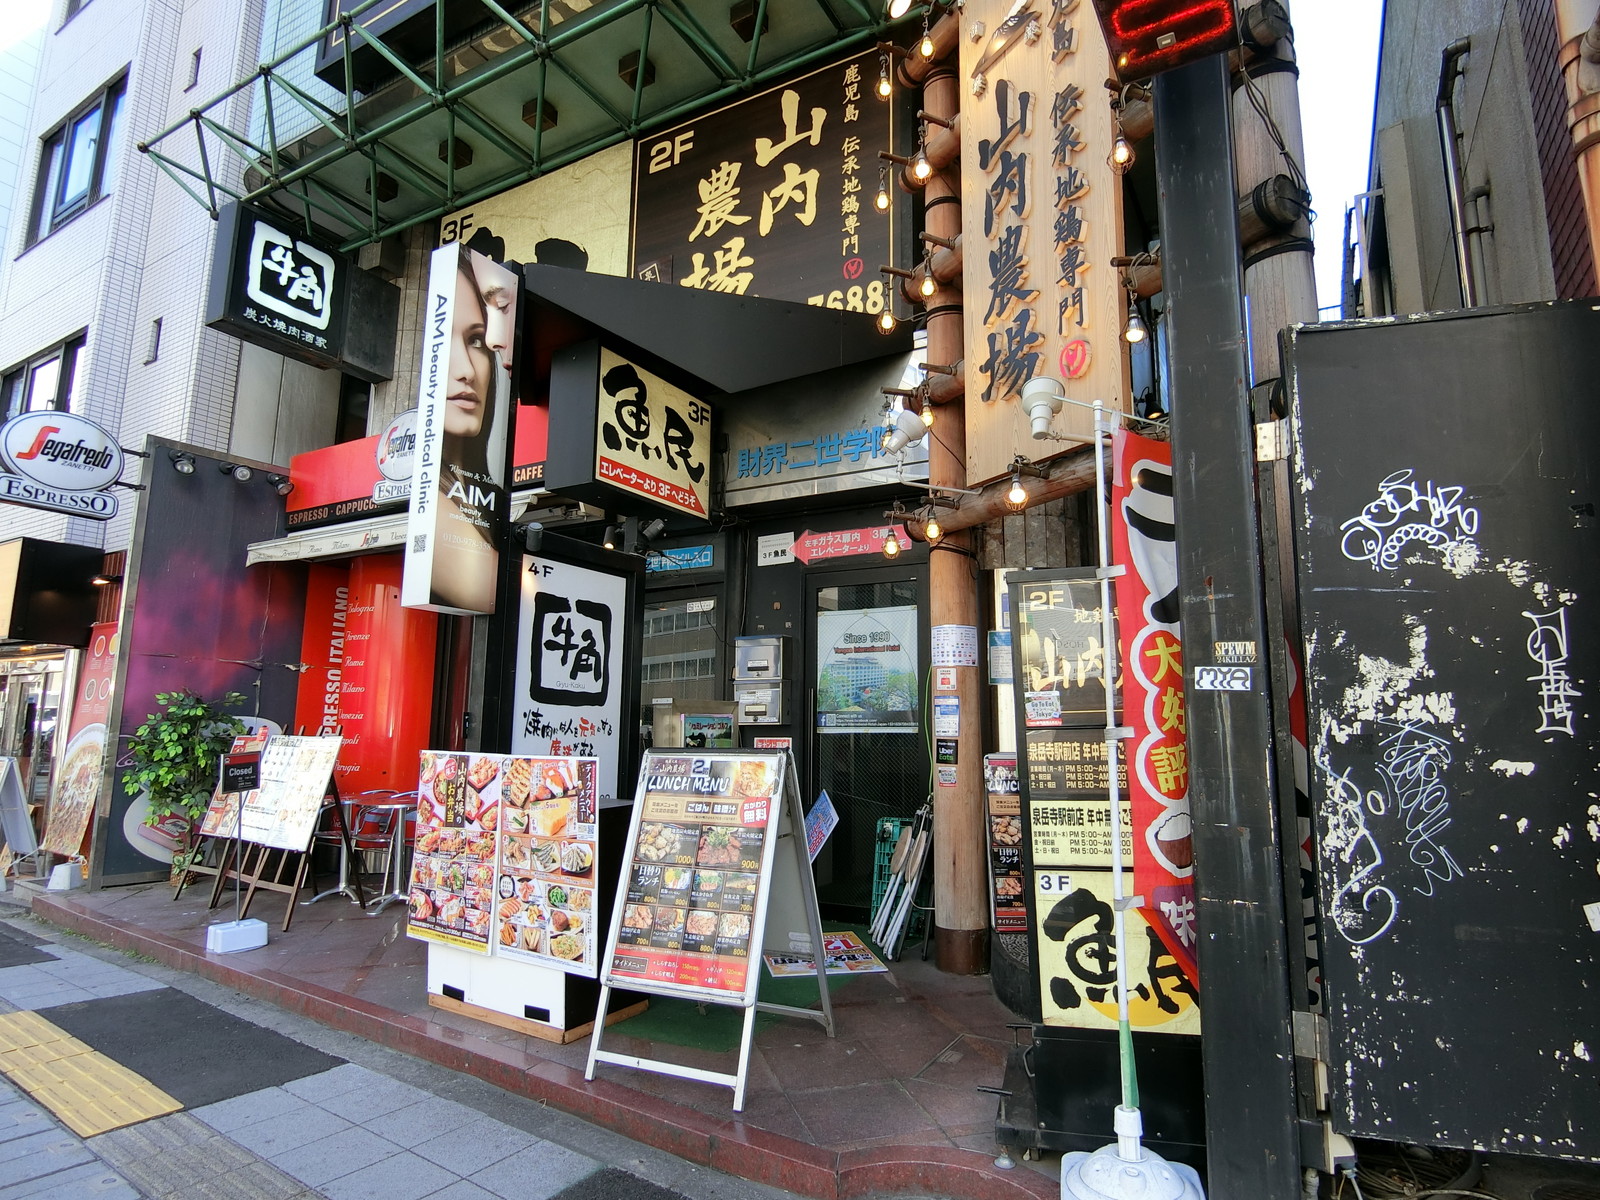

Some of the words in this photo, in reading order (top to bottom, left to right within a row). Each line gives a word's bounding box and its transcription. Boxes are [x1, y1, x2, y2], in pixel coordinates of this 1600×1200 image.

[841, 63, 862, 124] 鹿児島
[648, 130, 695, 175] 2F
[755, 89, 827, 237] 山内
[841, 136, 862, 257] 伝承地鶏専門
[1050, 83, 1088, 336] 伝承地鶏専門
[441, 213, 475, 247] 3F
[679, 160, 756, 298] 農場
[979, 79, 1045, 403] 山内農場
[433, 293, 448, 339] AIM
[243, 306, 329, 350] 炭火焼肉酒家
[426, 342, 444, 399] beauty
[687, 400, 710, 426] 3F
[602, 363, 705, 484] 魚民
[422, 403, 437, 467] medical
[16, 425, 115, 470] Segafredo
[380, 425, 417, 465] Segafre
[396, 450, 415, 459] ZANETT
[60, 460, 96, 473] ZANETTI
[514, 464, 544, 483] CAFFE
[6, 478, 109, 513] ESPRESSO
[417, 471, 433, 515] clinic
[446, 480, 496, 512] AIM
[288, 507, 329, 525] ESPRESSO
[449, 512, 475, 525] medical
[474, 516, 491, 529] clinic
[459, 504, 482, 518] beauty
[528, 562, 555, 578] 4F
[348, 604, 375, 617] Bologna
[1030, 590, 1064, 612] 2F
[328, 586, 349, 664] ITALIANO
[843, 632, 867, 644] Since
[869, 631, 891, 643] 1990
[344, 656, 365, 667] Roma
[341, 682, 366, 693] Milano
[555, 680, 587, 690] Gyu-Kaku
[338, 708, 365, 720] Venezia
[523, 707, 613, 740] 焼肉には人を元気にする
[342, 733, 361, 744] apoli
[938, 746, 954, 754] Uber
[1029, 742, 1081, 761] 泉岳寺駅前店
[1082, 742, 1108, 761] 年中無
[229, 766, 253, 777] Closed
[335, 760, 361, 771] Perugia
[1065, 764, 1076, 772] PM
[648, 775, 691, 791] LUNCH
[692, 776, 731, 792] MENU
[988, 779, 1019, 794] LUNC
[687, 803, 710, 812] ごはん
[743, 808, 767, 823] 無料
[1032, 807, 1085, 826] 泉岳寺駅前店
[1086, 808, 1111, 827] 年中無
[1069, 830, 1080, 838] PM
[1070, 847, 1081, 855] PM
[637, 877, 660, 886] ランチ
[1040, 875, 1070, 892] 3F
[1160, 895, 1197, 948] 味
